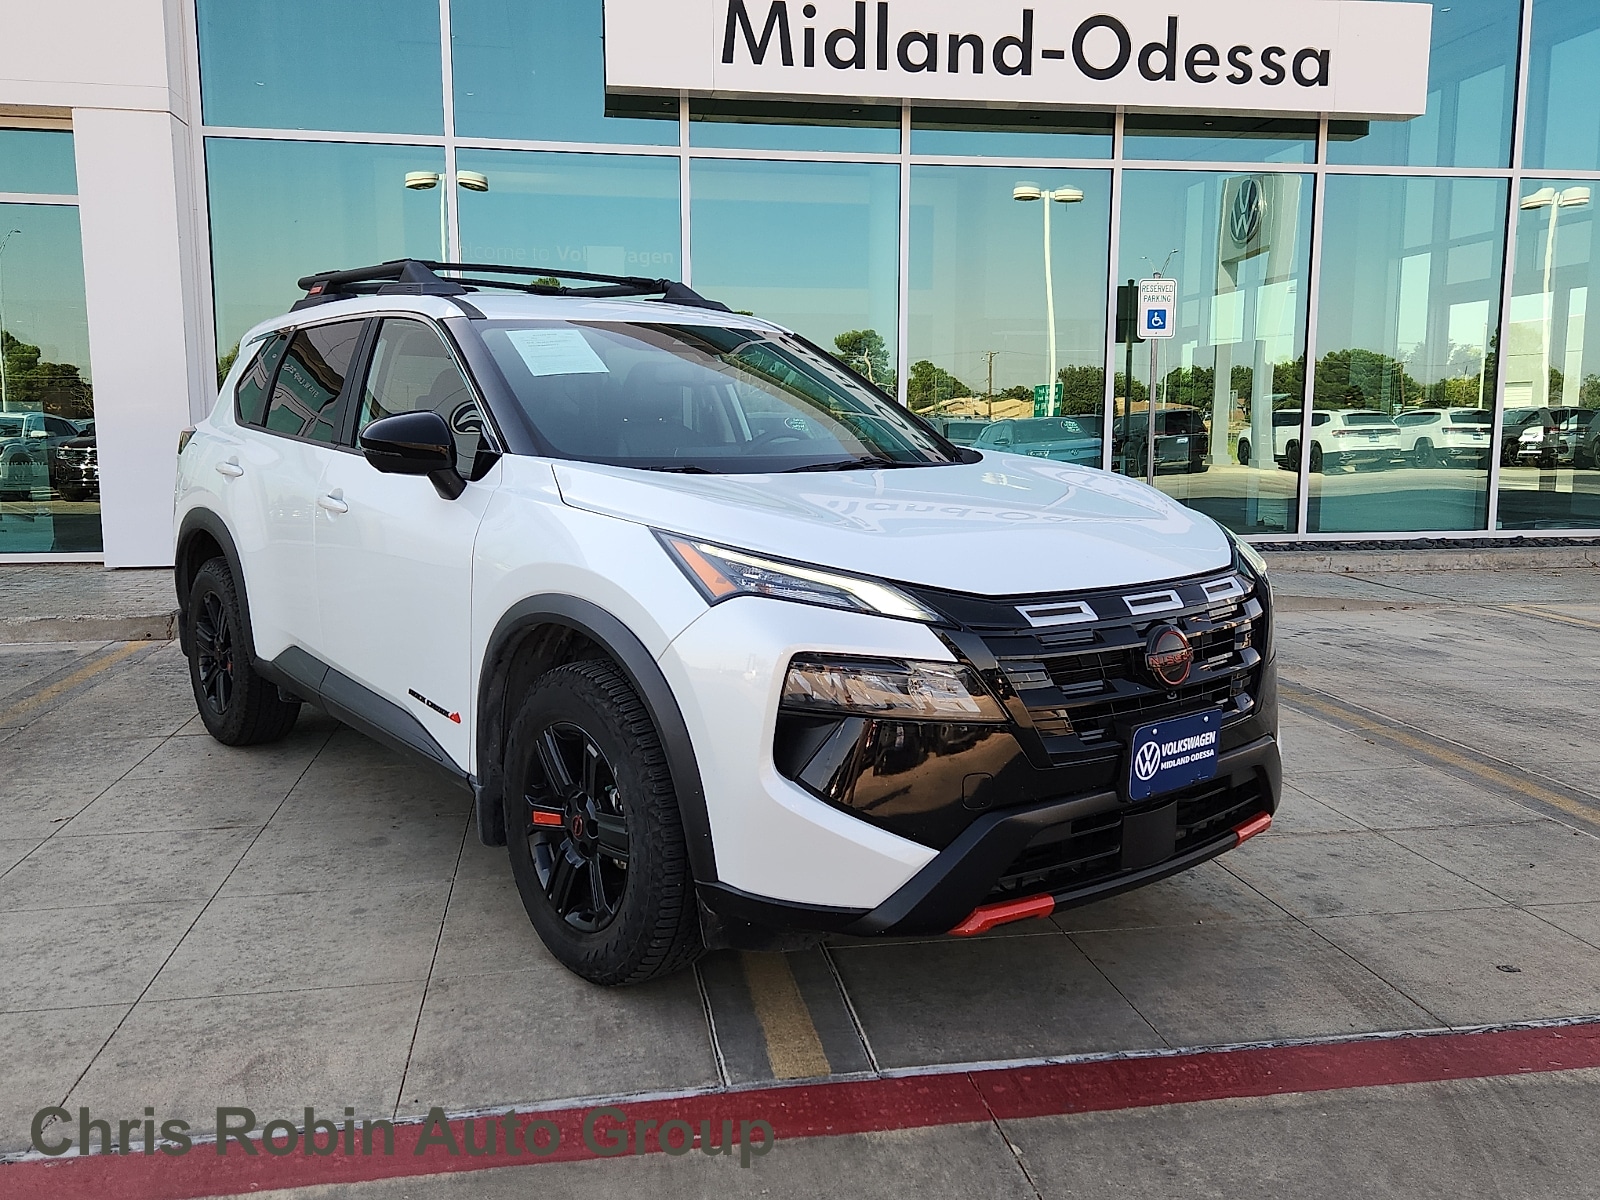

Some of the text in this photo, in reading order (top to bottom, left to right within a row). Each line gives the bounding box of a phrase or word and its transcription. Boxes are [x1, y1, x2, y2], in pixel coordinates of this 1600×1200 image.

[721, 0, 1331, 88] Midland-Odessa
[532, 245, 550, 262] to
[556, 245, 675, 267] Volagen
[1141, 284, 1174, 293] RESERVED
[1143, 294, 1171, 303] PARKING
[1161, 730, 1217, 757] VOLKSWAGEN
[1160, 748, 1215, 771] MIDLAND ODESSA
